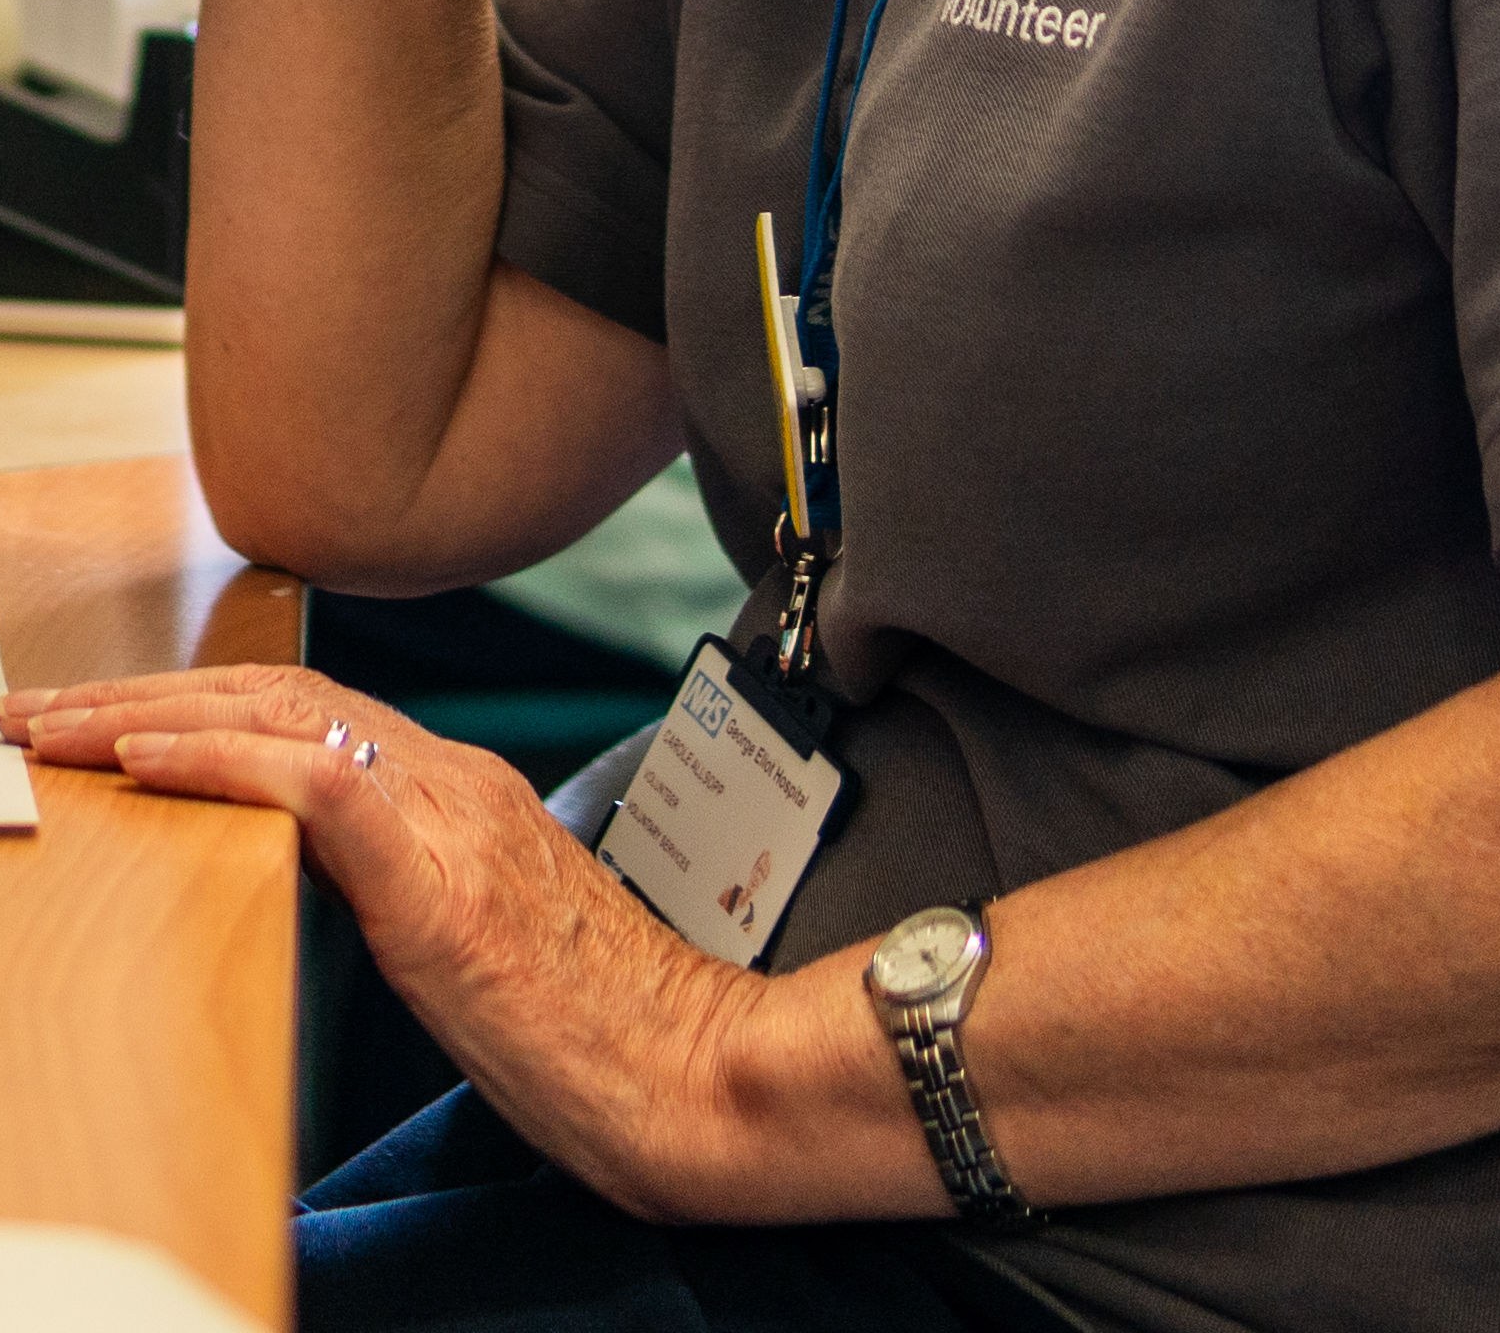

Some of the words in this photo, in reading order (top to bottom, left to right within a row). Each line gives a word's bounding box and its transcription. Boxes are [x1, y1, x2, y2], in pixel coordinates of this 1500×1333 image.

[681, 671, 732, 738] NHS
[726, 718, 756, 757] George
[753, 746, 777, 778] Eliot
[774, 766, 811, 811] Hospital
